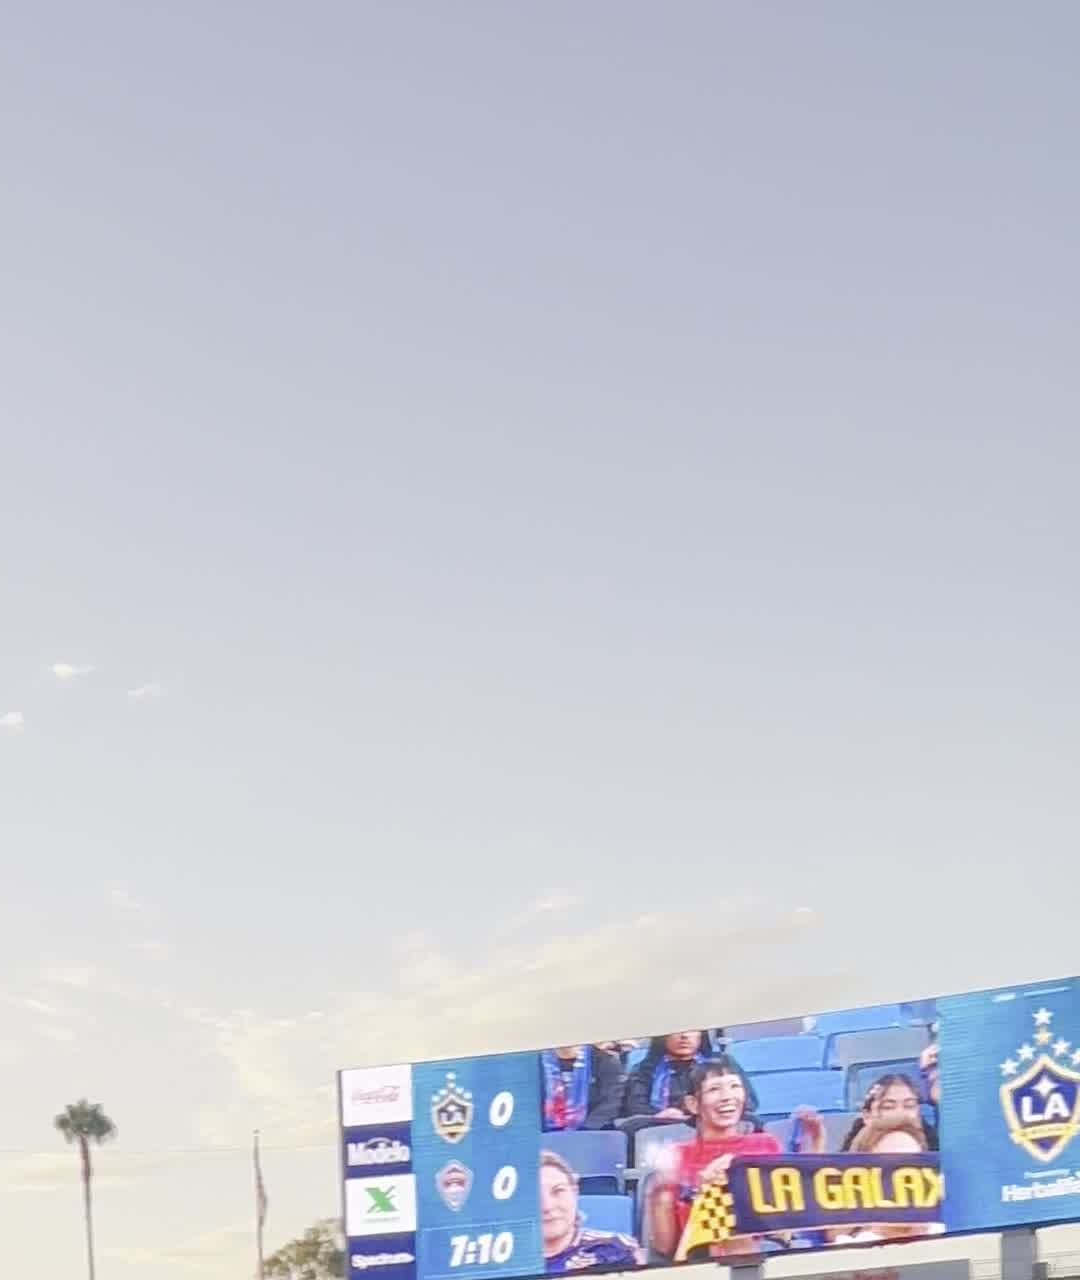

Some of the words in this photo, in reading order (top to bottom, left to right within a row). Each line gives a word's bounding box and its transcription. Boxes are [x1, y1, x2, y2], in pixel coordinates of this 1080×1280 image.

[488, 1091, 515, 1127] 0
[1021, 1093, 1071, 1123] LA
[492, 1165, 518, 1201] 0
[746, 1167, 806, 1213] LA
[449, 1231, 515, 1268] 7:10
